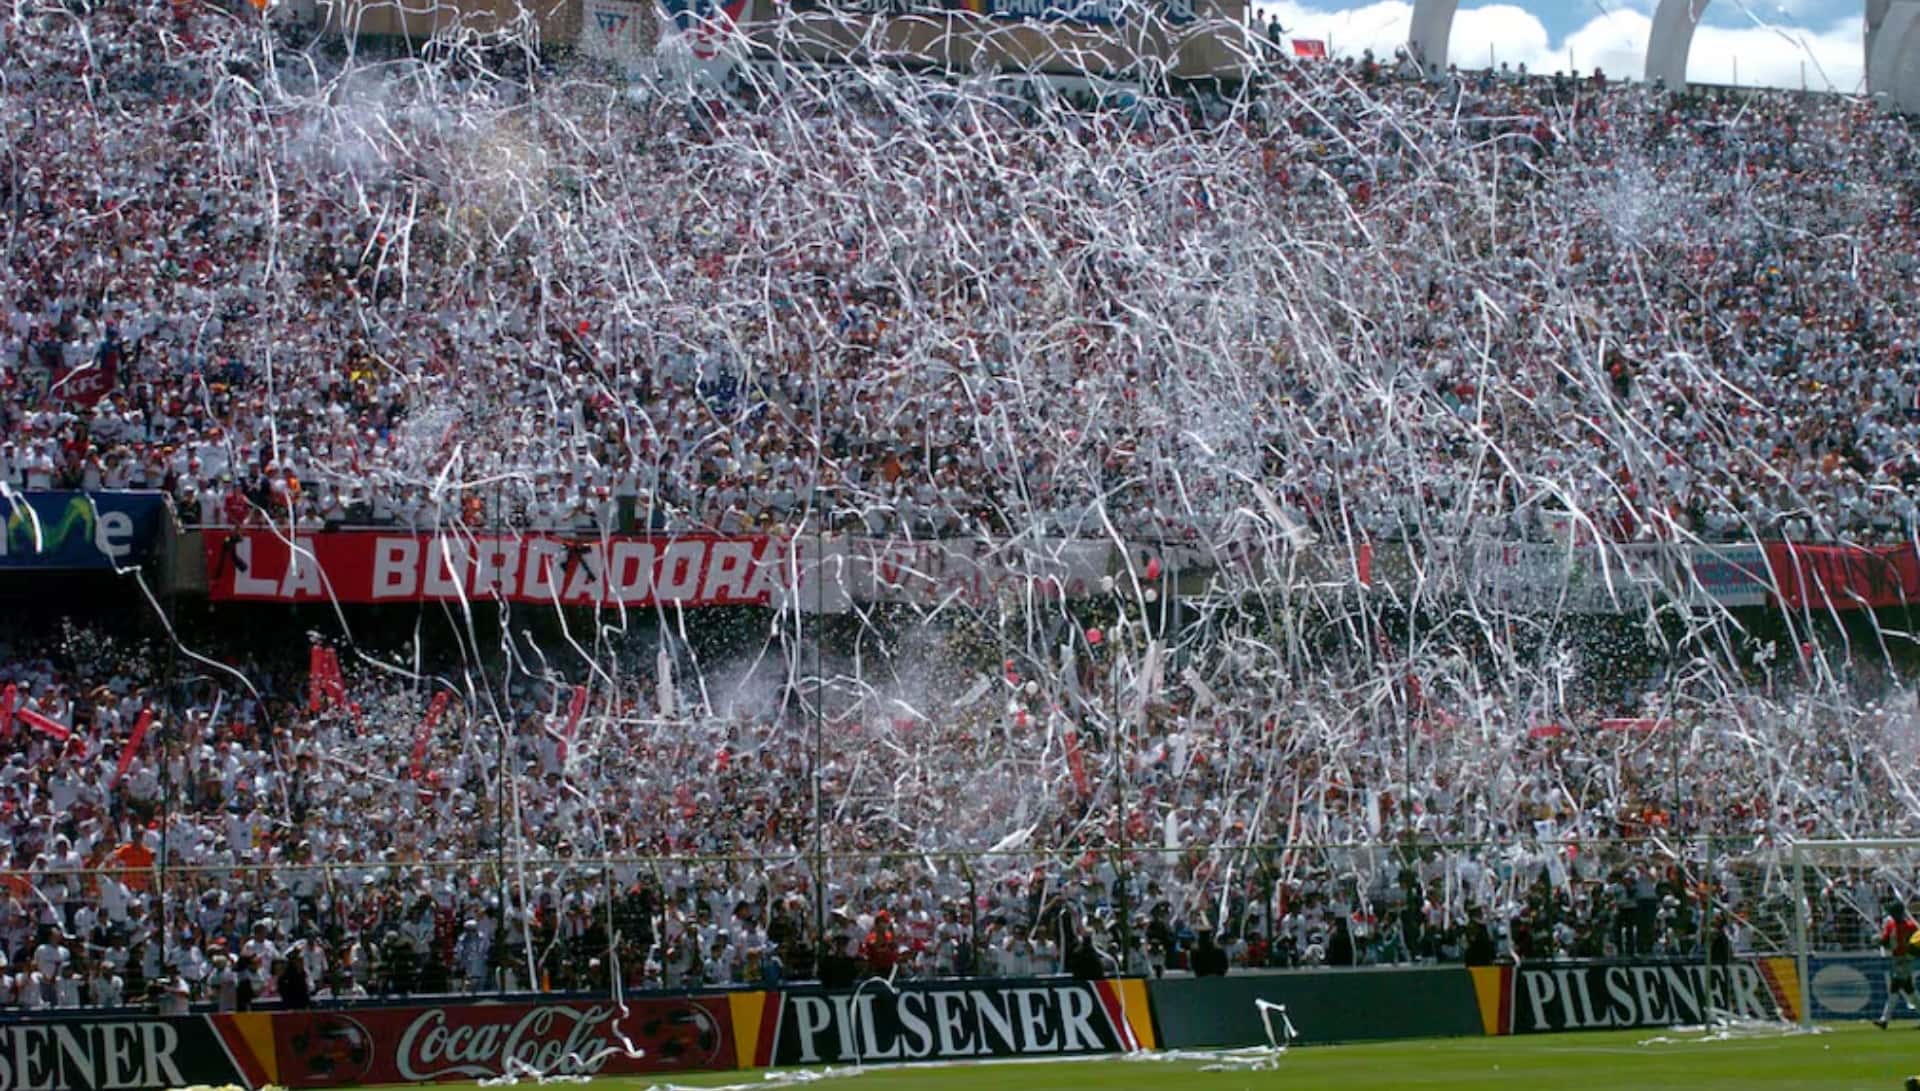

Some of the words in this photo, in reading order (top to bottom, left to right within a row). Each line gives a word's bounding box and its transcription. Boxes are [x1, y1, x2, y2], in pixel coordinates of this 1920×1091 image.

[233, 535, 322, 597] LA
[372, 533, 797, 602] BORDADORA
[787, 985, 1105, 1062] PILSENER
[1521, 962, 1773, 1031] PILSENER
